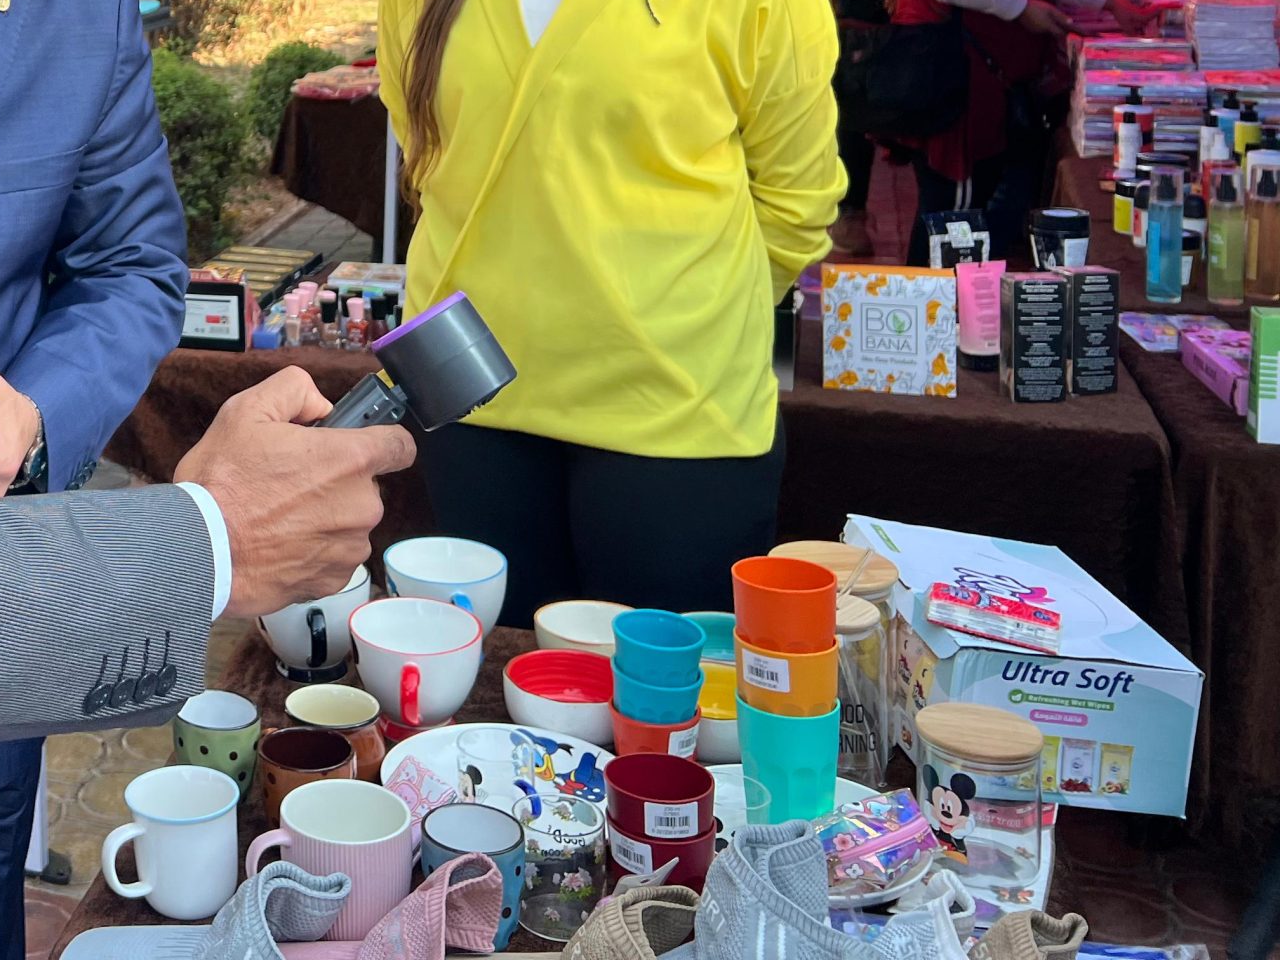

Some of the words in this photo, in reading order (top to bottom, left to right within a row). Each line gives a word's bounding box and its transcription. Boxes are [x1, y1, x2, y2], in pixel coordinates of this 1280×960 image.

[865, 307, 913, 334] BO
[865, 335, 912, 352] BANA
[1001, 660, 1070, 687] Ultra
[1075, 668, 1135, 698] Soft
